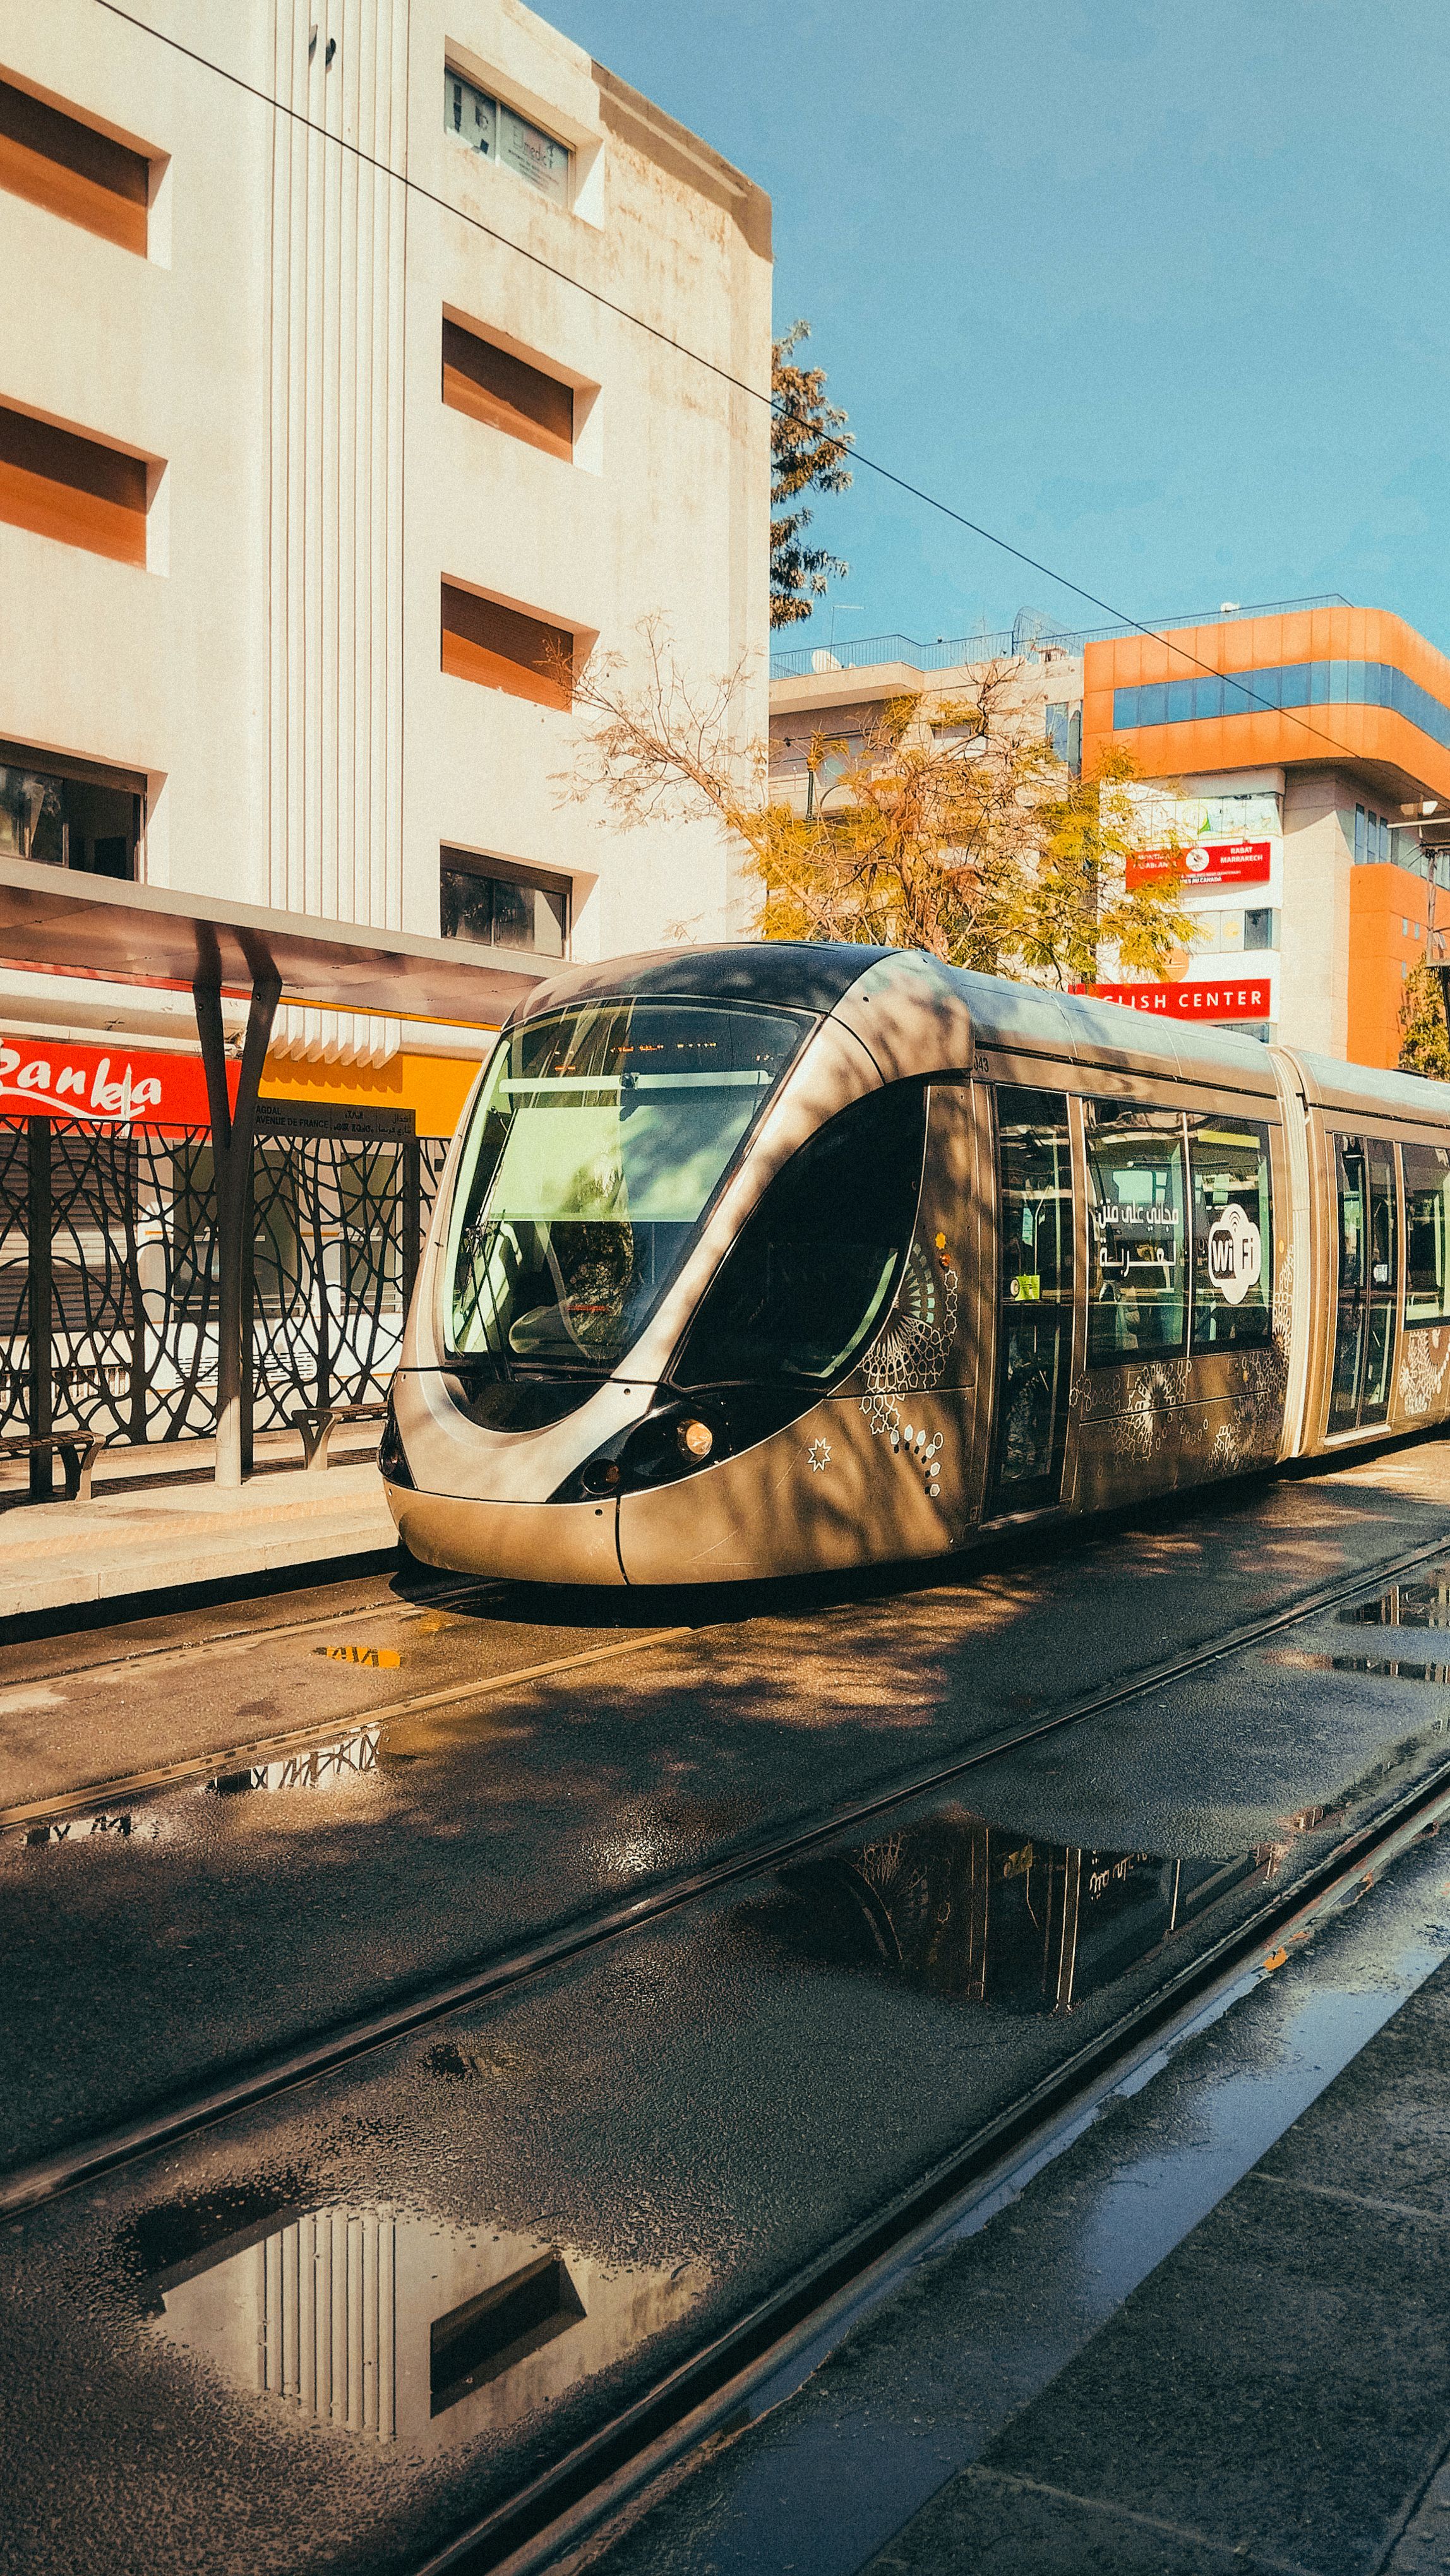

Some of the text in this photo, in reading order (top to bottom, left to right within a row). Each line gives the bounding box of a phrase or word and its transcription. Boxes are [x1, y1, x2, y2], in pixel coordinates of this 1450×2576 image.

[1230, 846, 1253, 854] RABAT
[1220, 854, 1263, 864] MARRAKECH
[1178, 990, 1262, 1007] CENTER
[255, 1105, 282, 1115] AGDAL
[255, 1115, 329, 1129] AVENUE DE FRANCE
[1121, 1200, 1144, 1224] على
